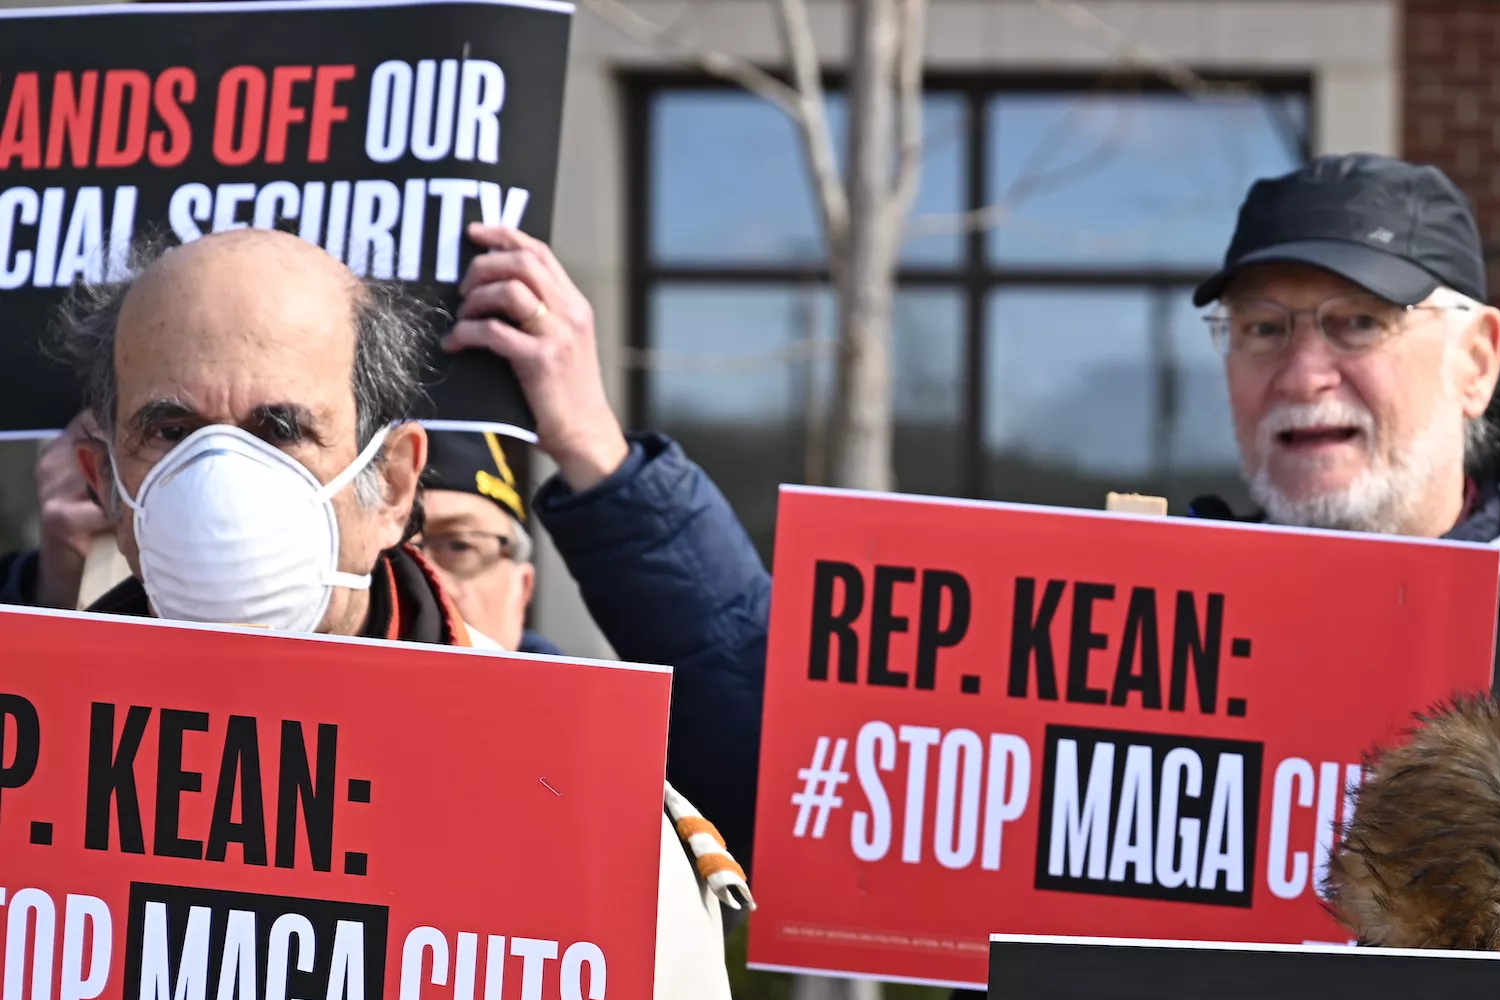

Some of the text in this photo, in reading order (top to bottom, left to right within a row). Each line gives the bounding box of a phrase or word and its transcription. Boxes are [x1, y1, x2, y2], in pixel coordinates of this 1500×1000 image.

[0, 59, 505, 169] ANDS OFF OUR
[808, 560, 1252, 717] REP. KEAN:
[84, 702, 371, 876] KEAN:
[791, 721, 1366, 902] #STOP MAGA CU
